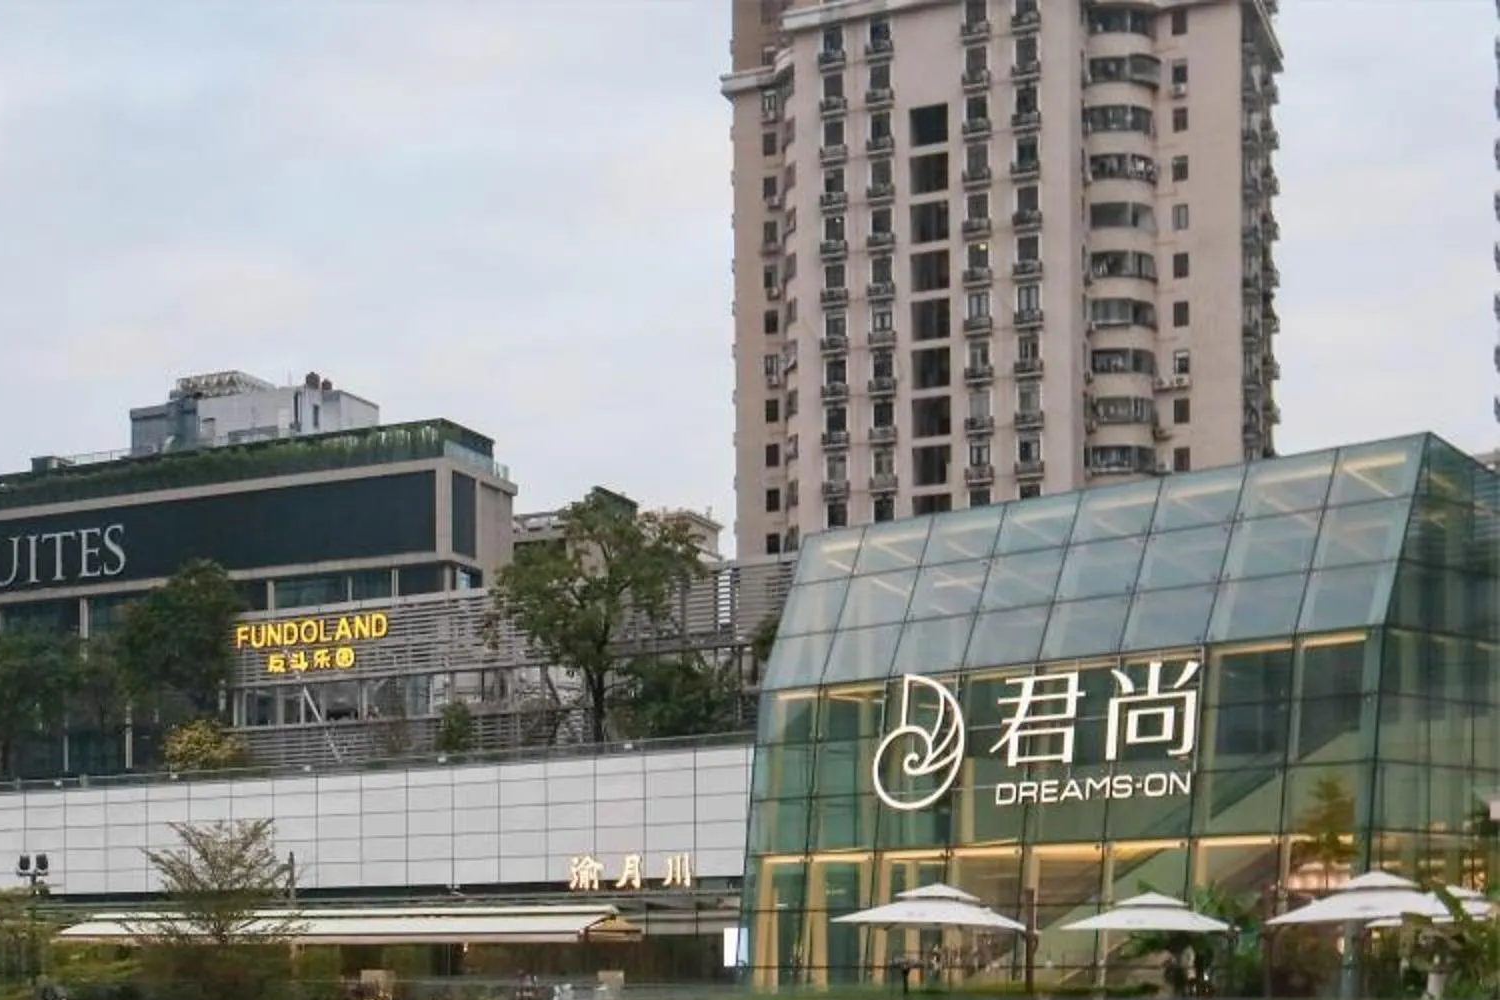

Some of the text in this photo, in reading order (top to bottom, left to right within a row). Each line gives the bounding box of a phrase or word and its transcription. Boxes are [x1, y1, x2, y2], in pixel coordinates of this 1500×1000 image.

[236, 613, 388, 649] FUNDOLAND
[989, 661, 1199, 767] 君尚
[995, 771, 1192, 805] DREAMS-ON
